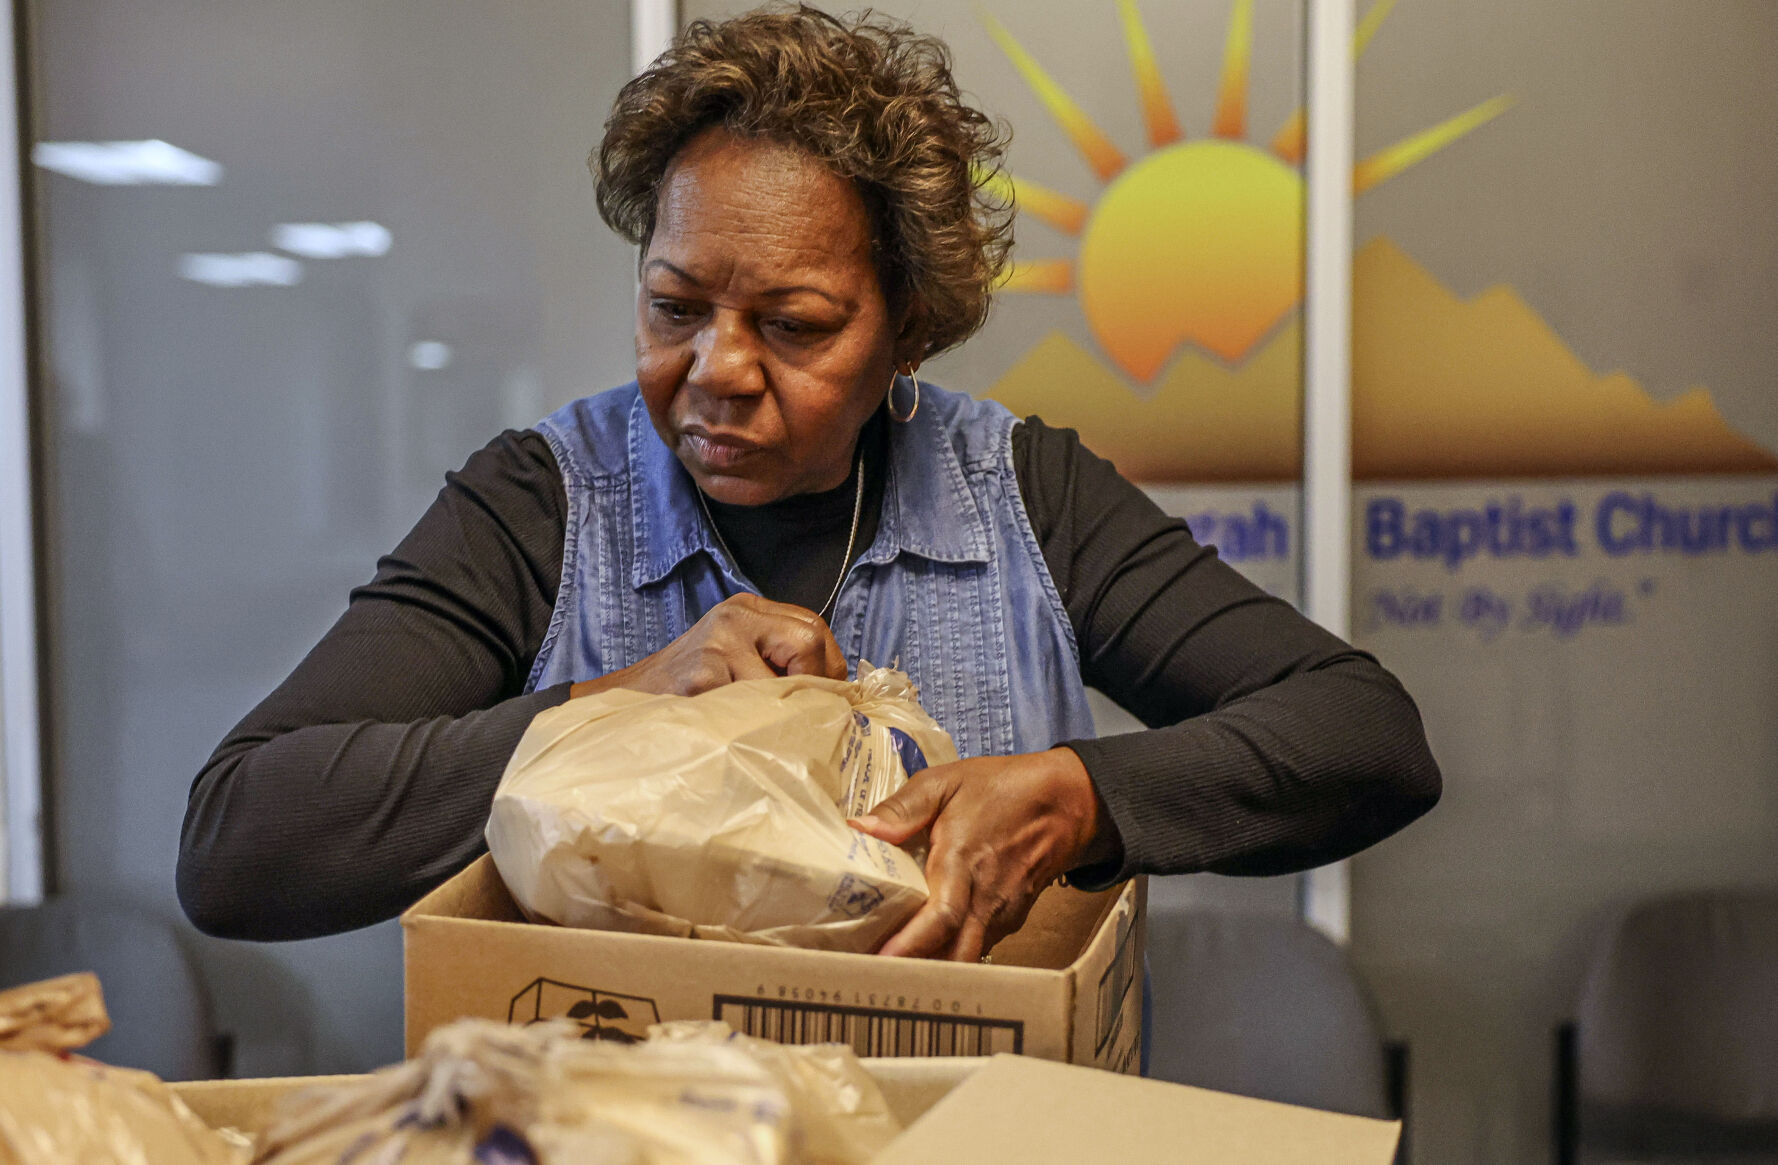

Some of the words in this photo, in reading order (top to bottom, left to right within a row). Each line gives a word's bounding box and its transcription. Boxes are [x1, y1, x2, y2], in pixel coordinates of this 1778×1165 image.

[1186, 500, 1289, 560] rah
[1366, 497, 1578, 571] Baptist
[1596, 490, 1778, 557] Churc
